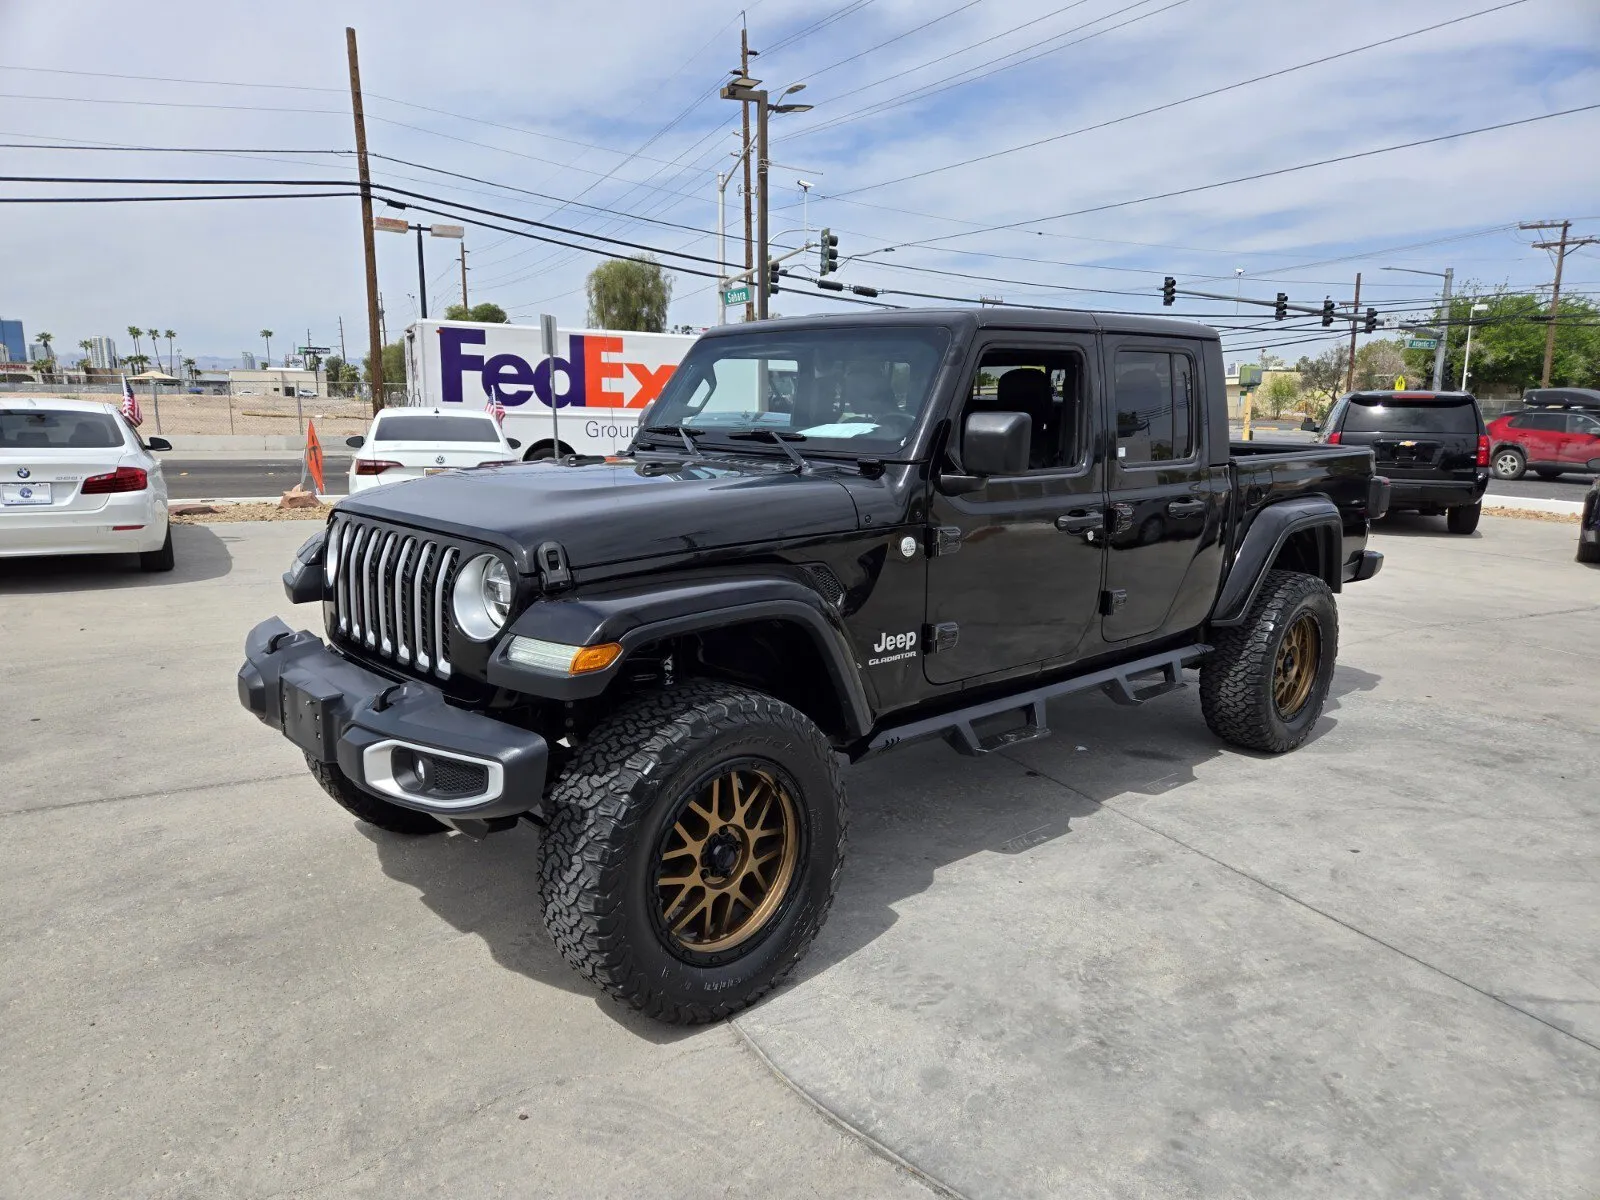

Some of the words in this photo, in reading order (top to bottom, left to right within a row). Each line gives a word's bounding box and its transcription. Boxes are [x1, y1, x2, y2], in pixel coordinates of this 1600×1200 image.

[727, 291, 746, 303] Sahara
[439, 327, 677, 409] FedEx
[873, 631, 917, 653] Jeep
[868, 651, 917, 666] GLADIATOR
